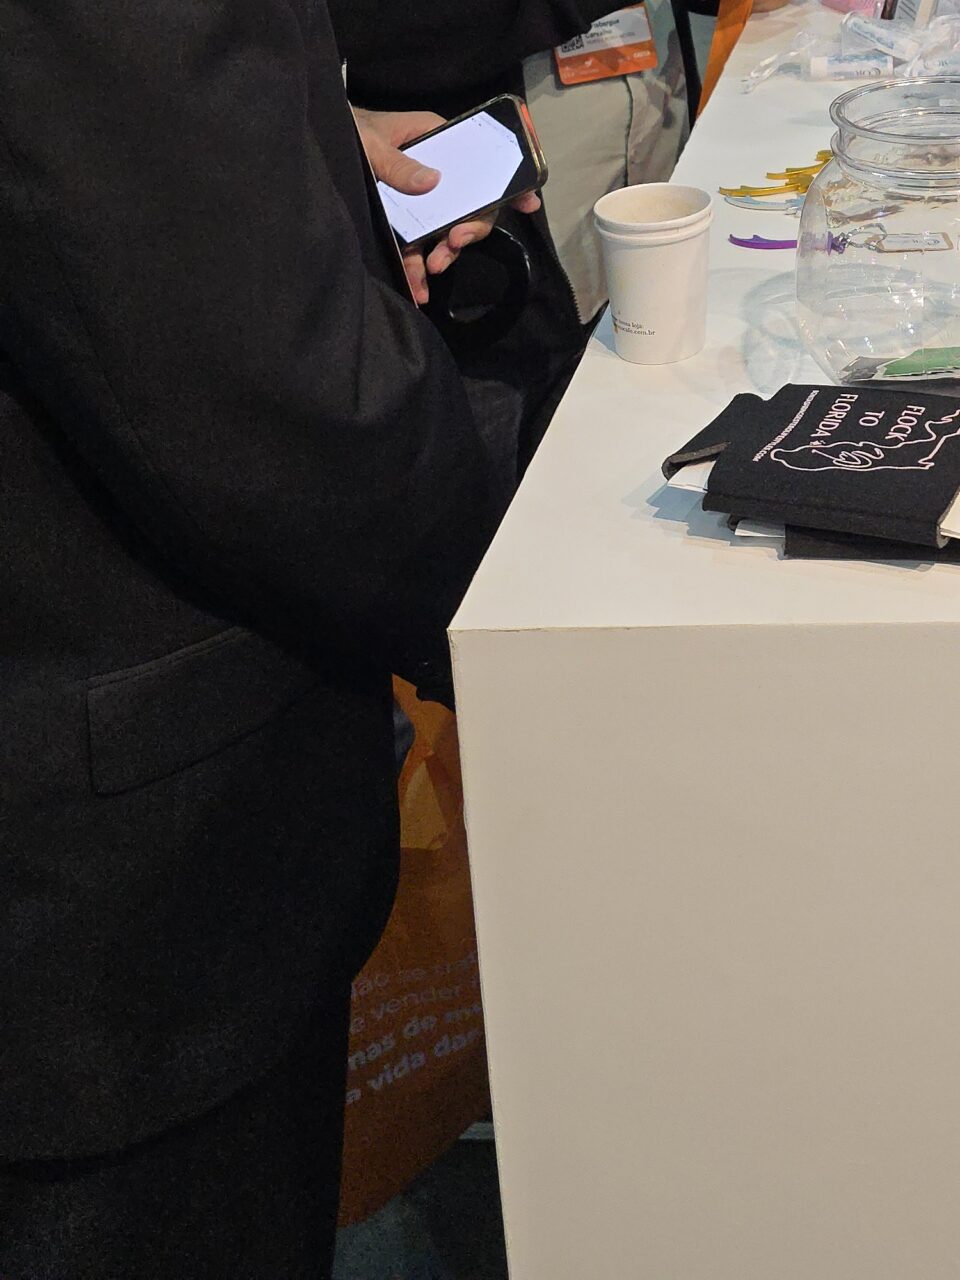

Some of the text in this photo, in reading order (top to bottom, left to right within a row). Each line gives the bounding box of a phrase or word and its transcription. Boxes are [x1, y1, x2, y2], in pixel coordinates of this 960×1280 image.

[810, 392, 859, 438] FLORIDA
[859, 410, 885, 426] TO
[884, 404, 926, 441] FLOCK
[367, 1051, 426, 1090] vida
